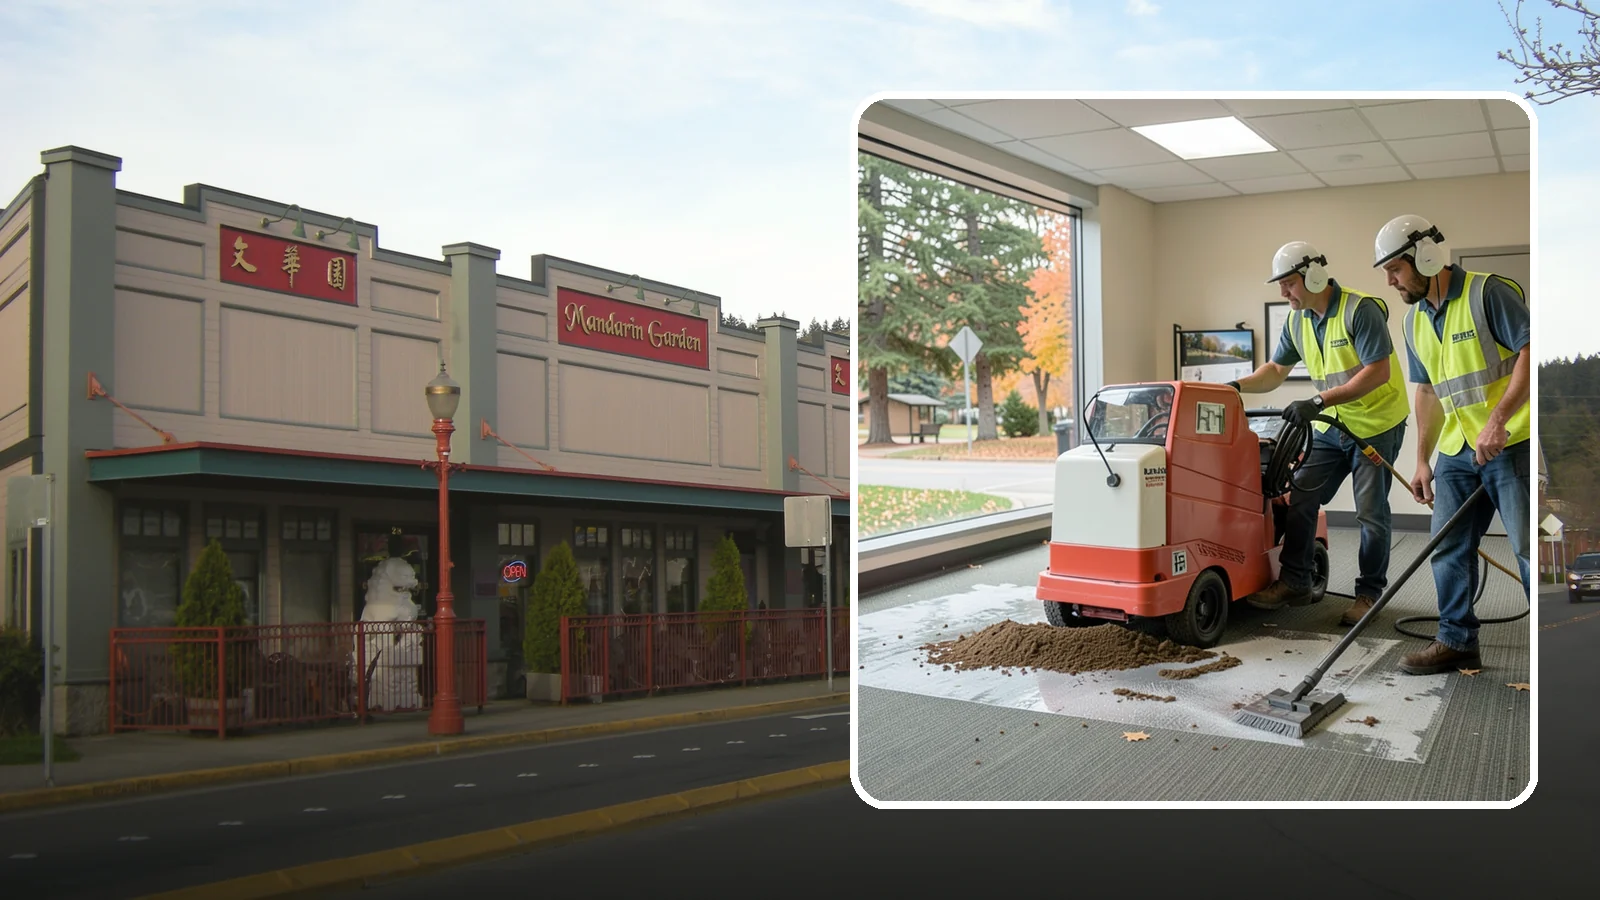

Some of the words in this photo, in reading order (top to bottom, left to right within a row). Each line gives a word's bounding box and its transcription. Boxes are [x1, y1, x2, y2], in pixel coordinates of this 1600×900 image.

[231, 235, 346, 291] 文華園
[564, 302, 644, 341] Mandarin
[648, 320, 701, 352] Garden
[503, 565, 527, 578] OPEN
